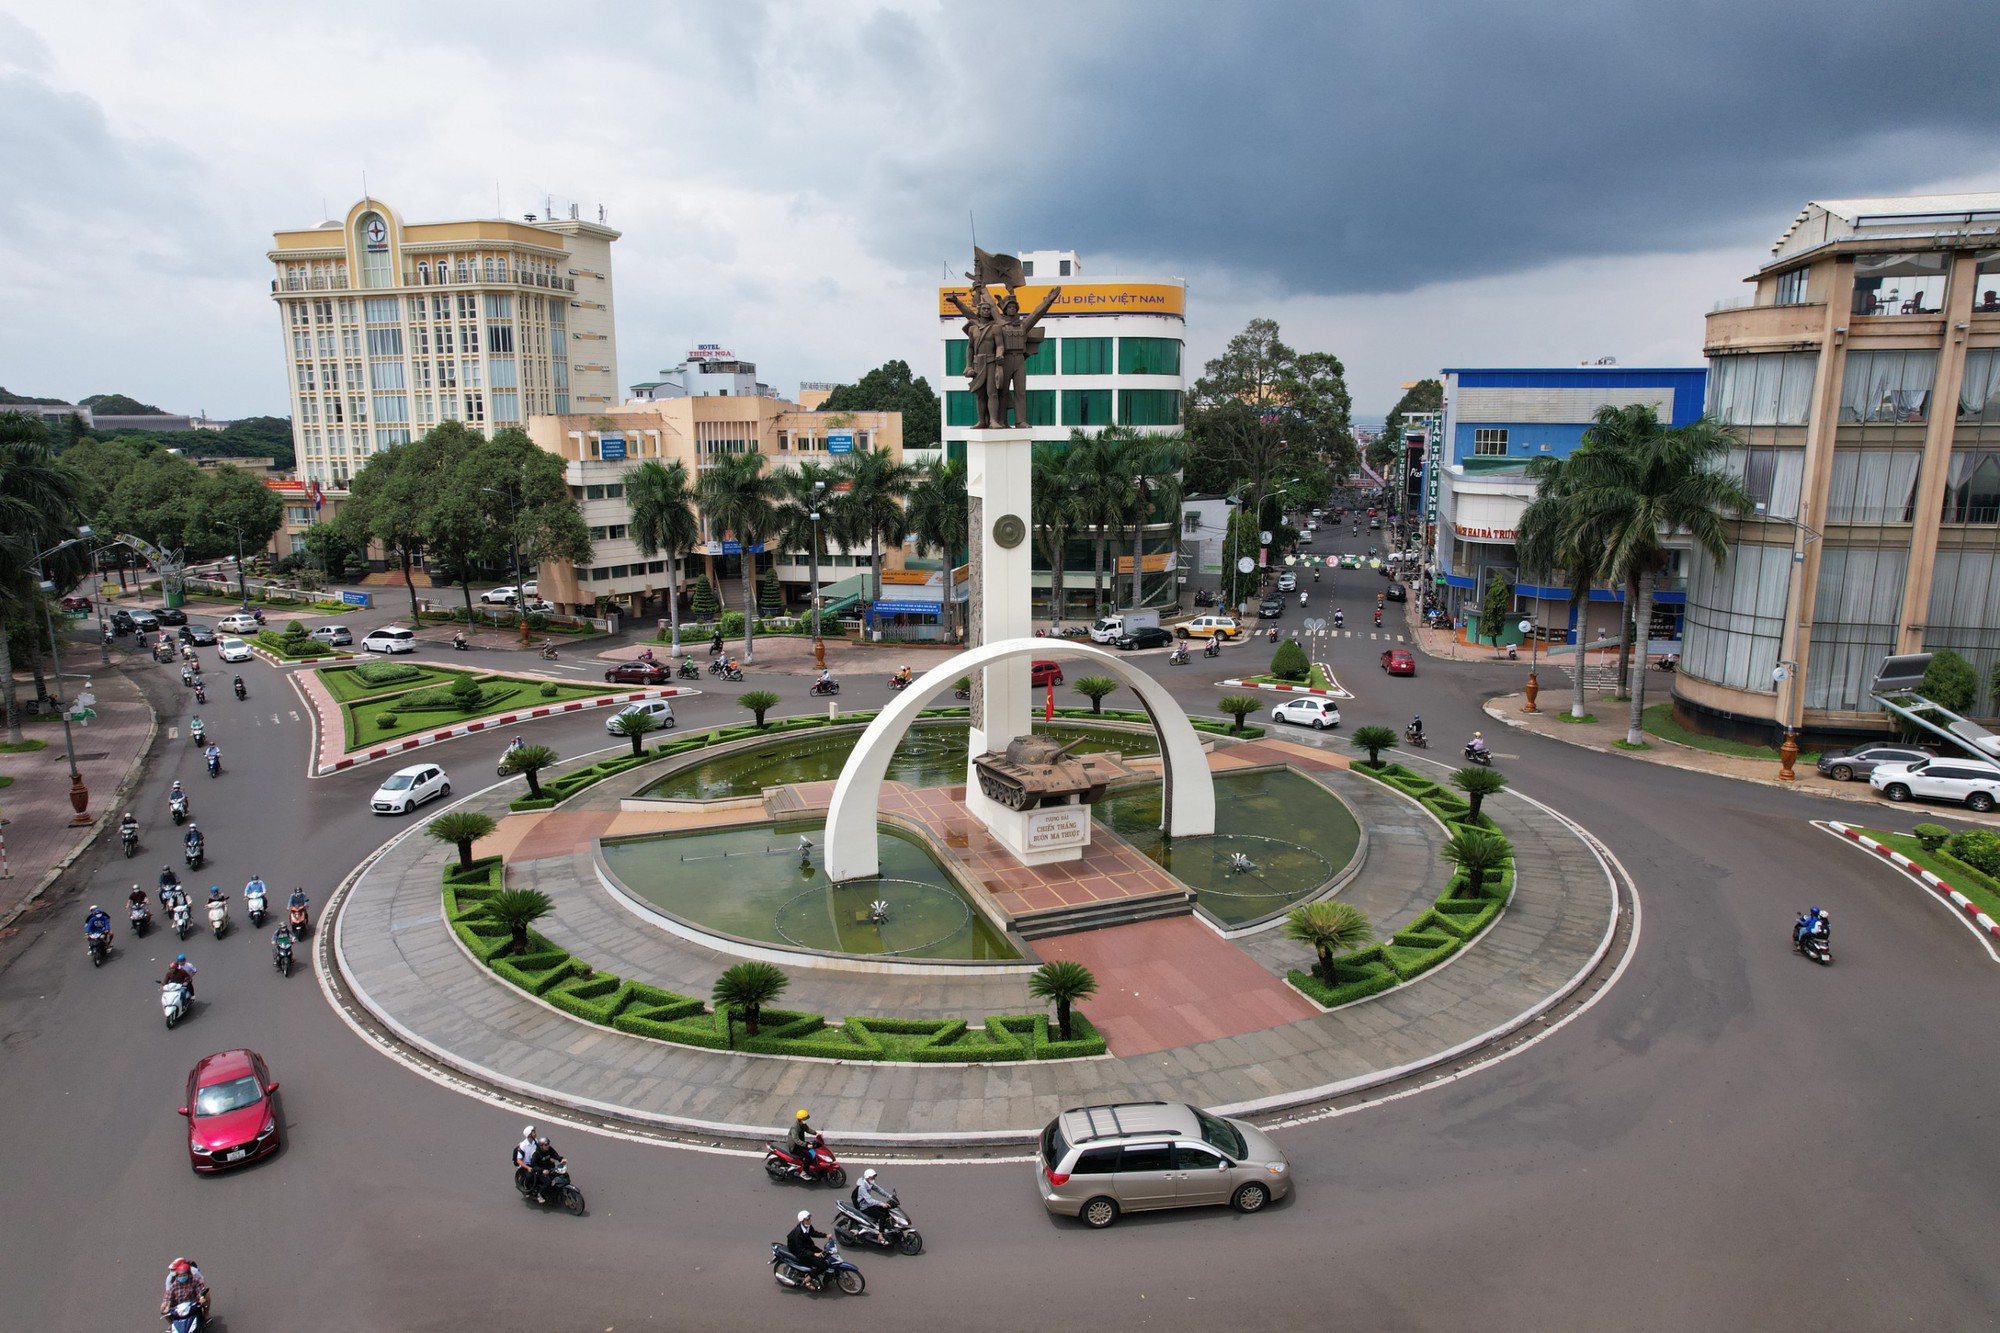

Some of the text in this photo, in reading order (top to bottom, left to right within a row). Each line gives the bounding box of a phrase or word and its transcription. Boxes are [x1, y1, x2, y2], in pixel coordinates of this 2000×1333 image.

[1043, 292, 1165, 305] ƯU ĐIỆN VIỆT NAM
[1433, 419, 1441, 442] TÂN
[1429, 480, 1437, 511] BÌNH
[1468, 527, 1480, 538] HAI
[1481, 526, 1492, 539] BÀ
[1493, 528, 1519, 540] TRƯN
[1037, 821, 1076, 832] CHIẾN THẮNG
